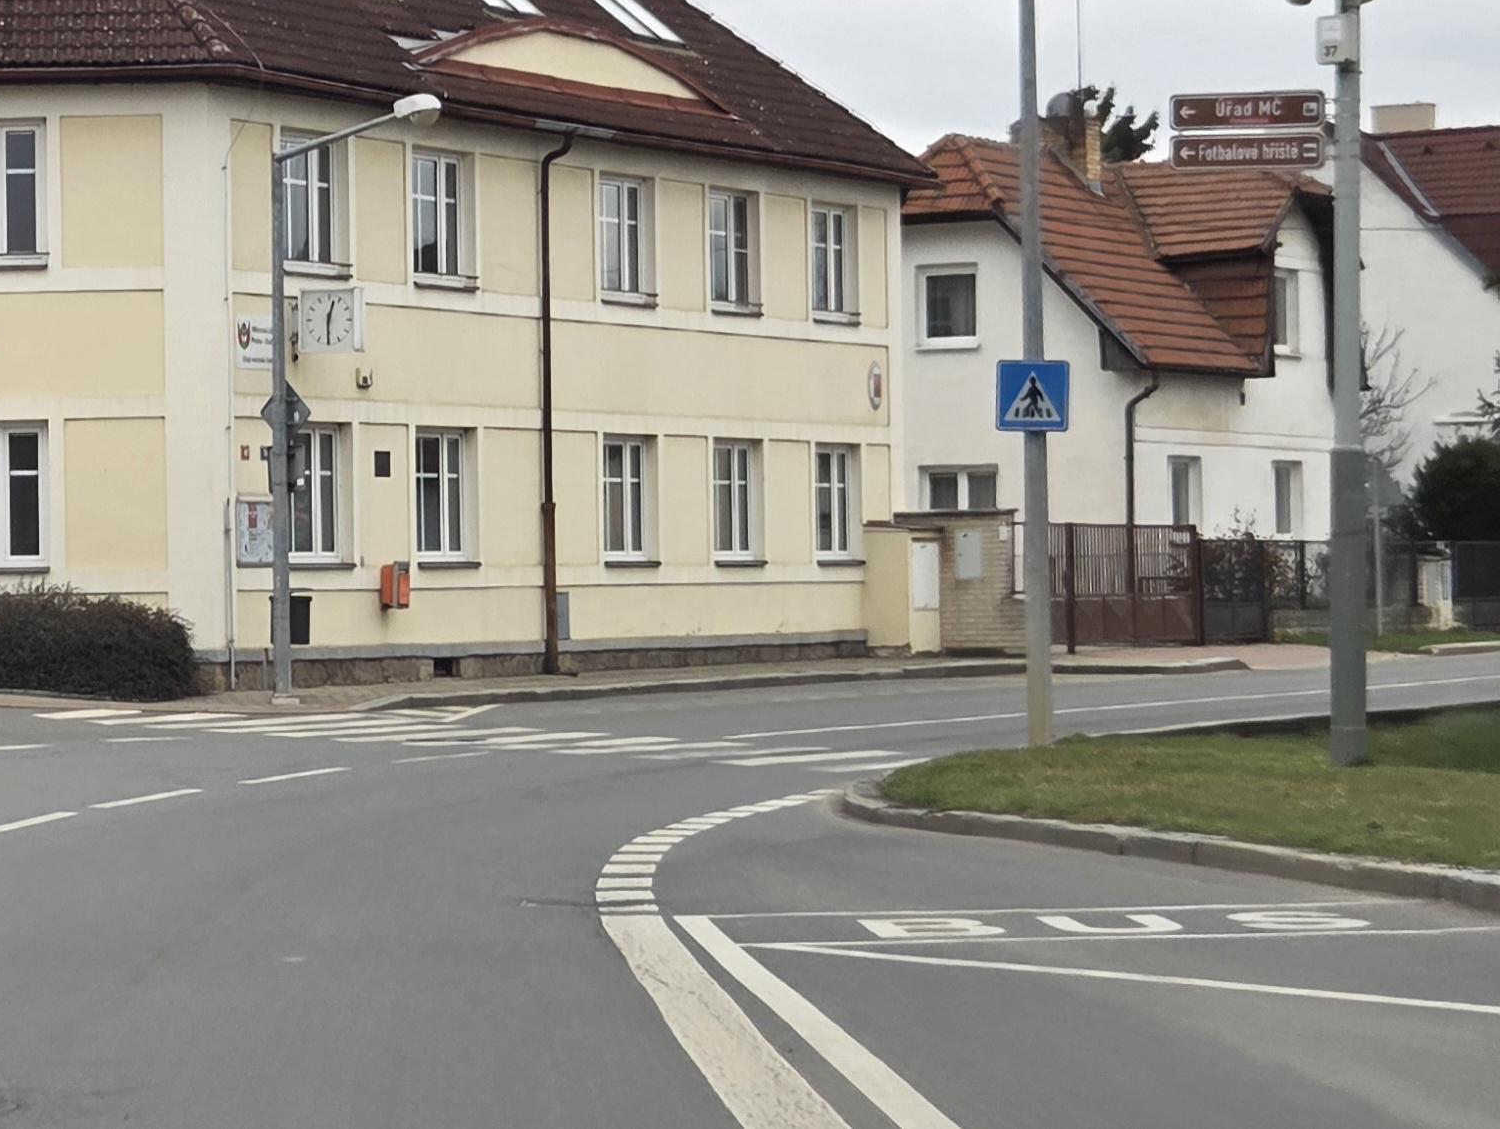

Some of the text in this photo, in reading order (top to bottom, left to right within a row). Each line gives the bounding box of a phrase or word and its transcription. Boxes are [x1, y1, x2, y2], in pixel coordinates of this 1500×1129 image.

[1215, 97, 1283, 118] Úřad MČ
[1198, 142, 1299, 162] Fotbalové hřiště
[856, 911, 1371, 938] BUS
